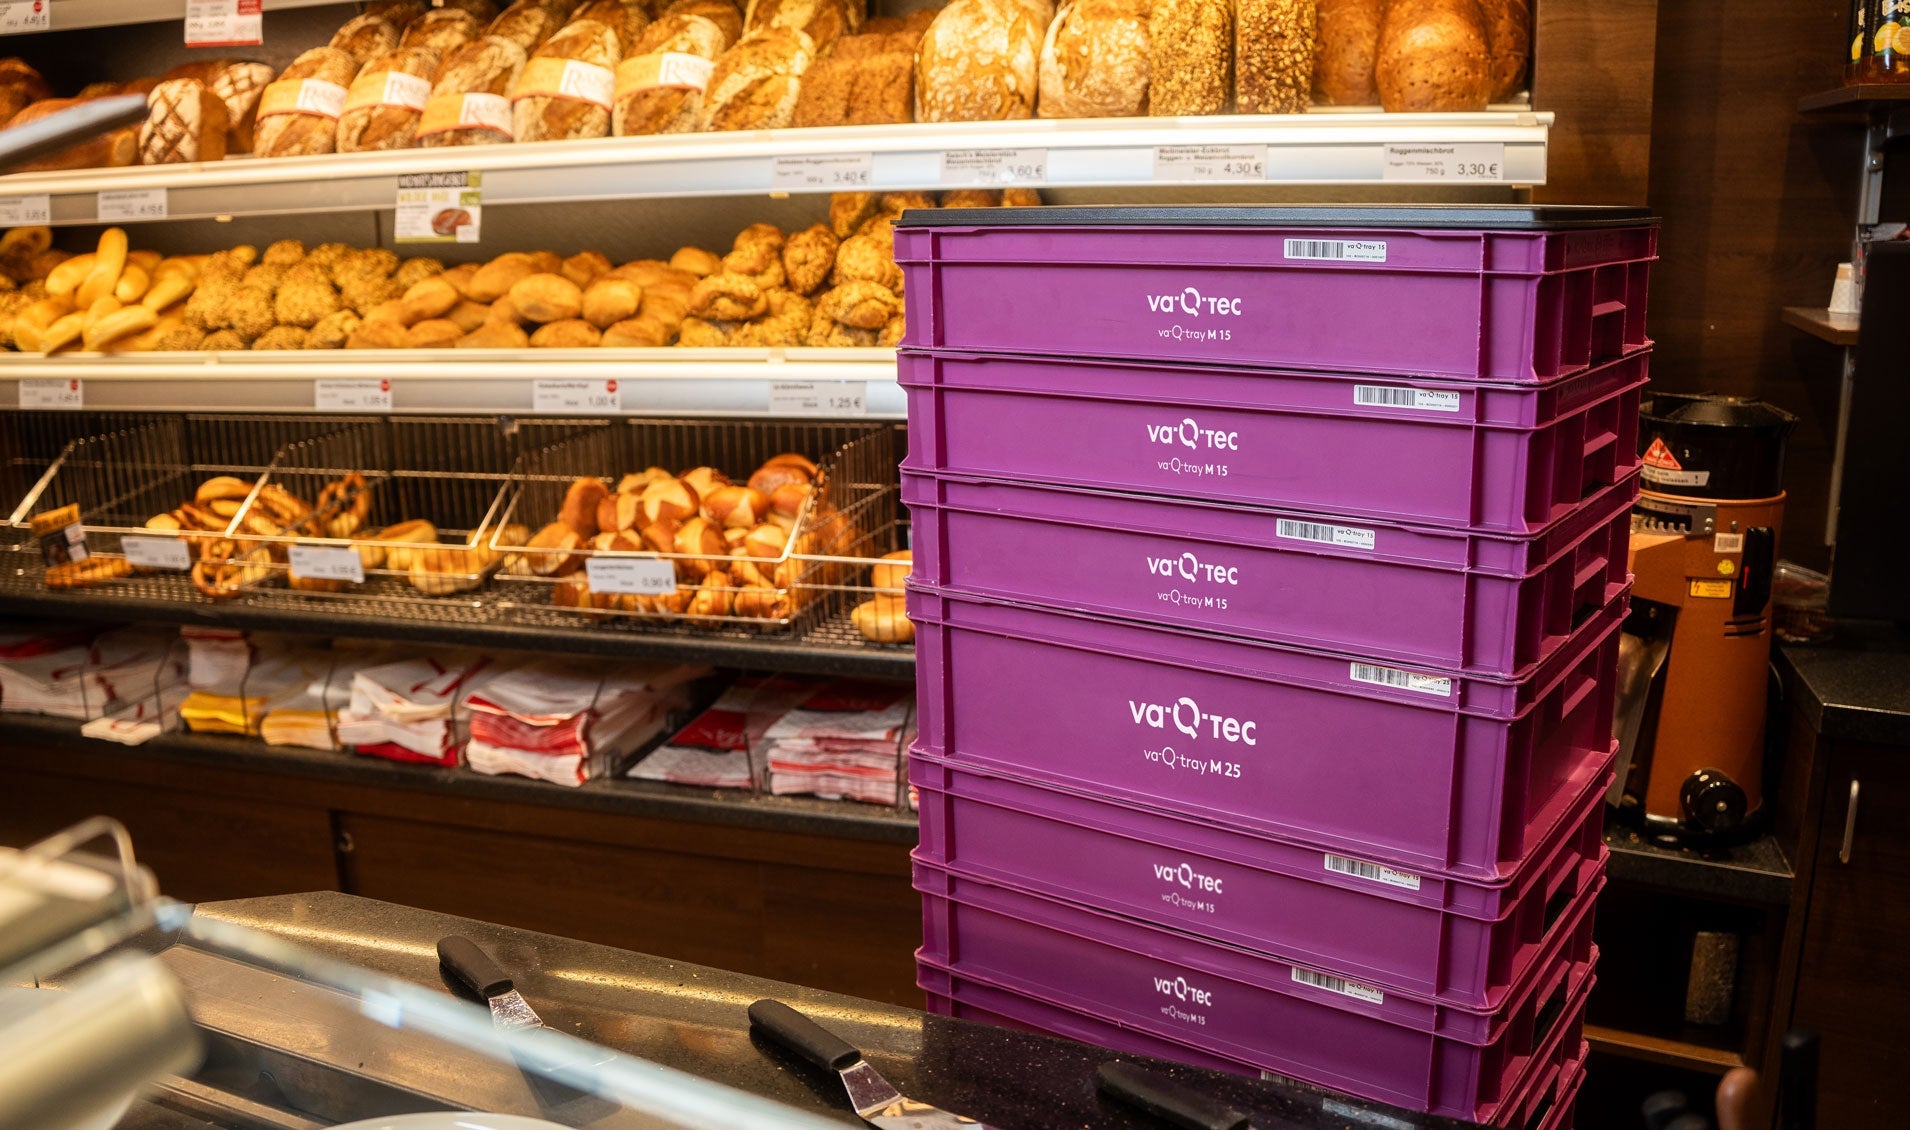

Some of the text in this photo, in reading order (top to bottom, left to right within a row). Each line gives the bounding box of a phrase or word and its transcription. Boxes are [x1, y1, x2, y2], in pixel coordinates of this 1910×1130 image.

[1035, 165, 1043, 175] €
[1224, 162, 1251, 175] 4,30
[1254, 162, 1262, 173] €
[1457, 163, 1486, 176] 3,30
[1489, 163, 1498, 175] €
[860, 171, 867, 181] €
[1207, 329, 1217, 340] M
[1219, 330, 1231, 341] 15
[829, 398, 851, 408] 1,25
[854, 397, 861, 408] €
[1205, 464, 1214, 475] M
[1216, 464, 1228, 476] 15
[1204, 596, 1213, 608] M
[1216, 598, 1228, 610] 15
[1210, 759, 1221, 774] M
[1225, 762, 1241, 778] 25
[1197, 901, 1204, 911] M
[1206, 903, 1215, 913] 15
[1190, 1013, 1197, 1023] M
[1198, 1015, 1206, 1026] 15
